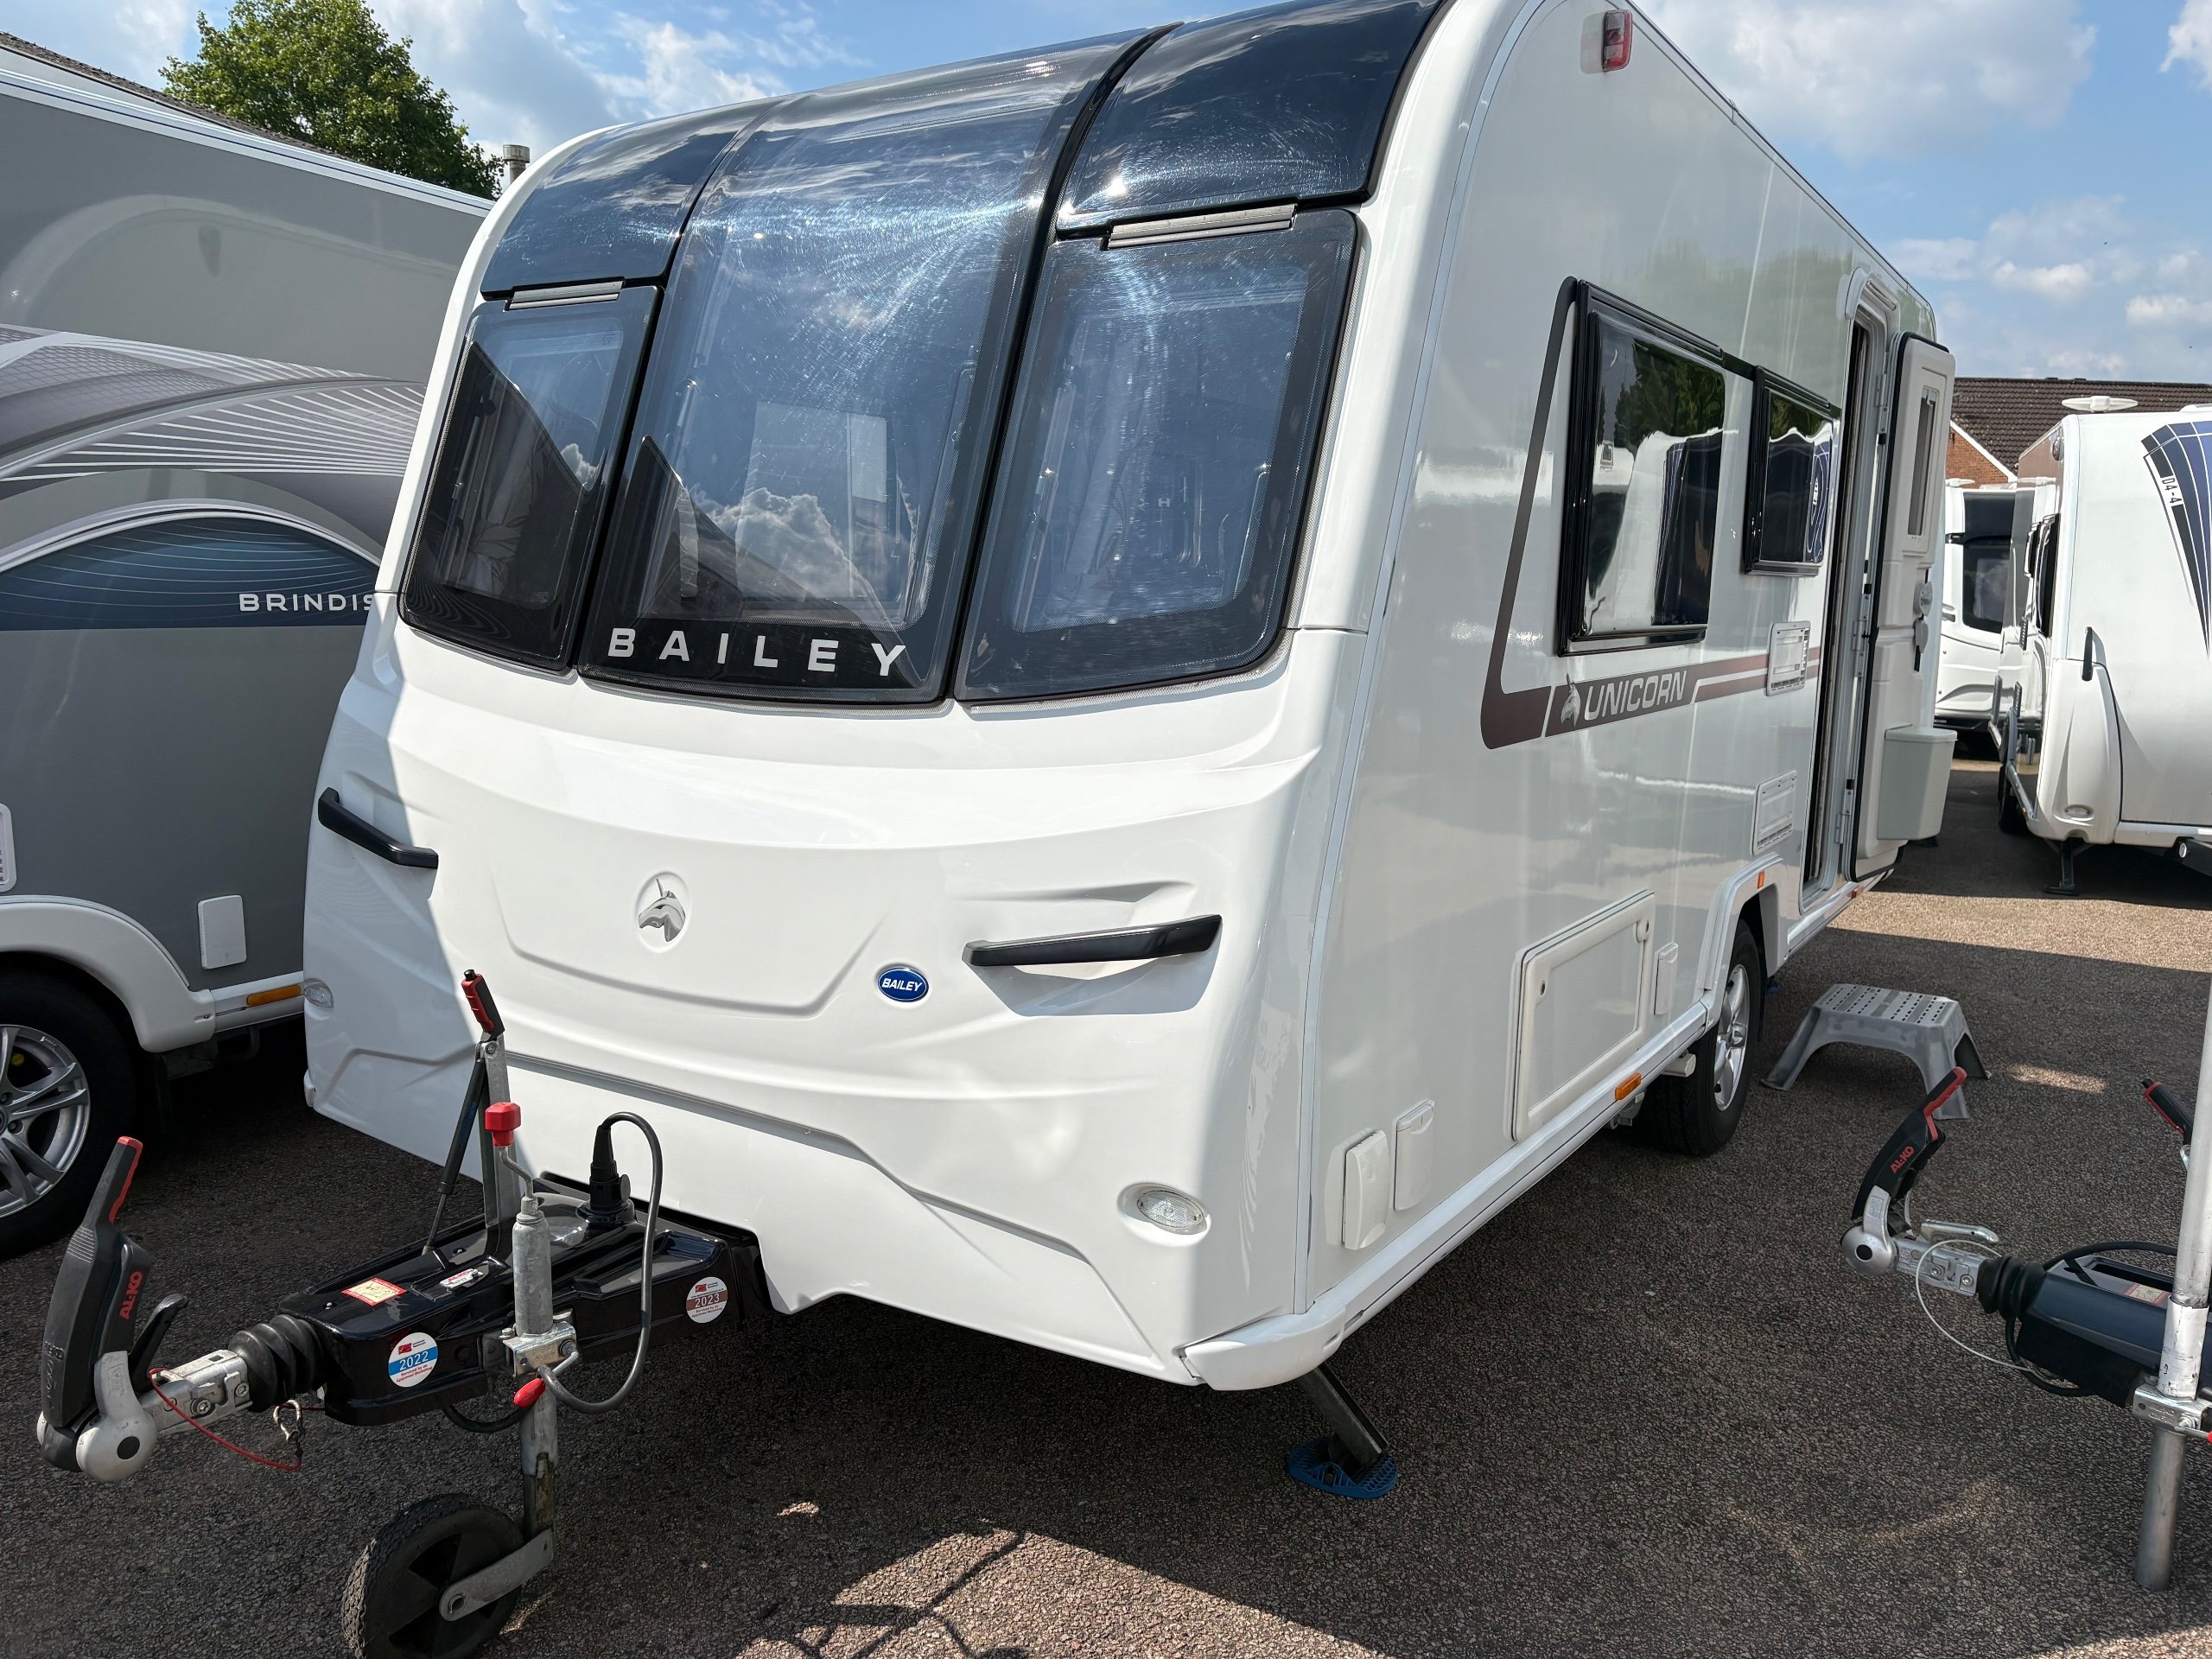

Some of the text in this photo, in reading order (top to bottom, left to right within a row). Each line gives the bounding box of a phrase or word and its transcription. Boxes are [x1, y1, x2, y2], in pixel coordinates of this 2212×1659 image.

[2162, 478, 2182, 504] D4-4
[607, 627, 906, 677] BAILEY
[1584, 670, 1688, 721] UNICORN
[881, 977, 923, 992] BAILEY
[1890, 1145, 1916, 1175] AL-KO
[119, 1271, 143, 1320] AL-KO
[695, 1293, 720, 1308] 2023
[399, 1351, 429, 1371] 2022
